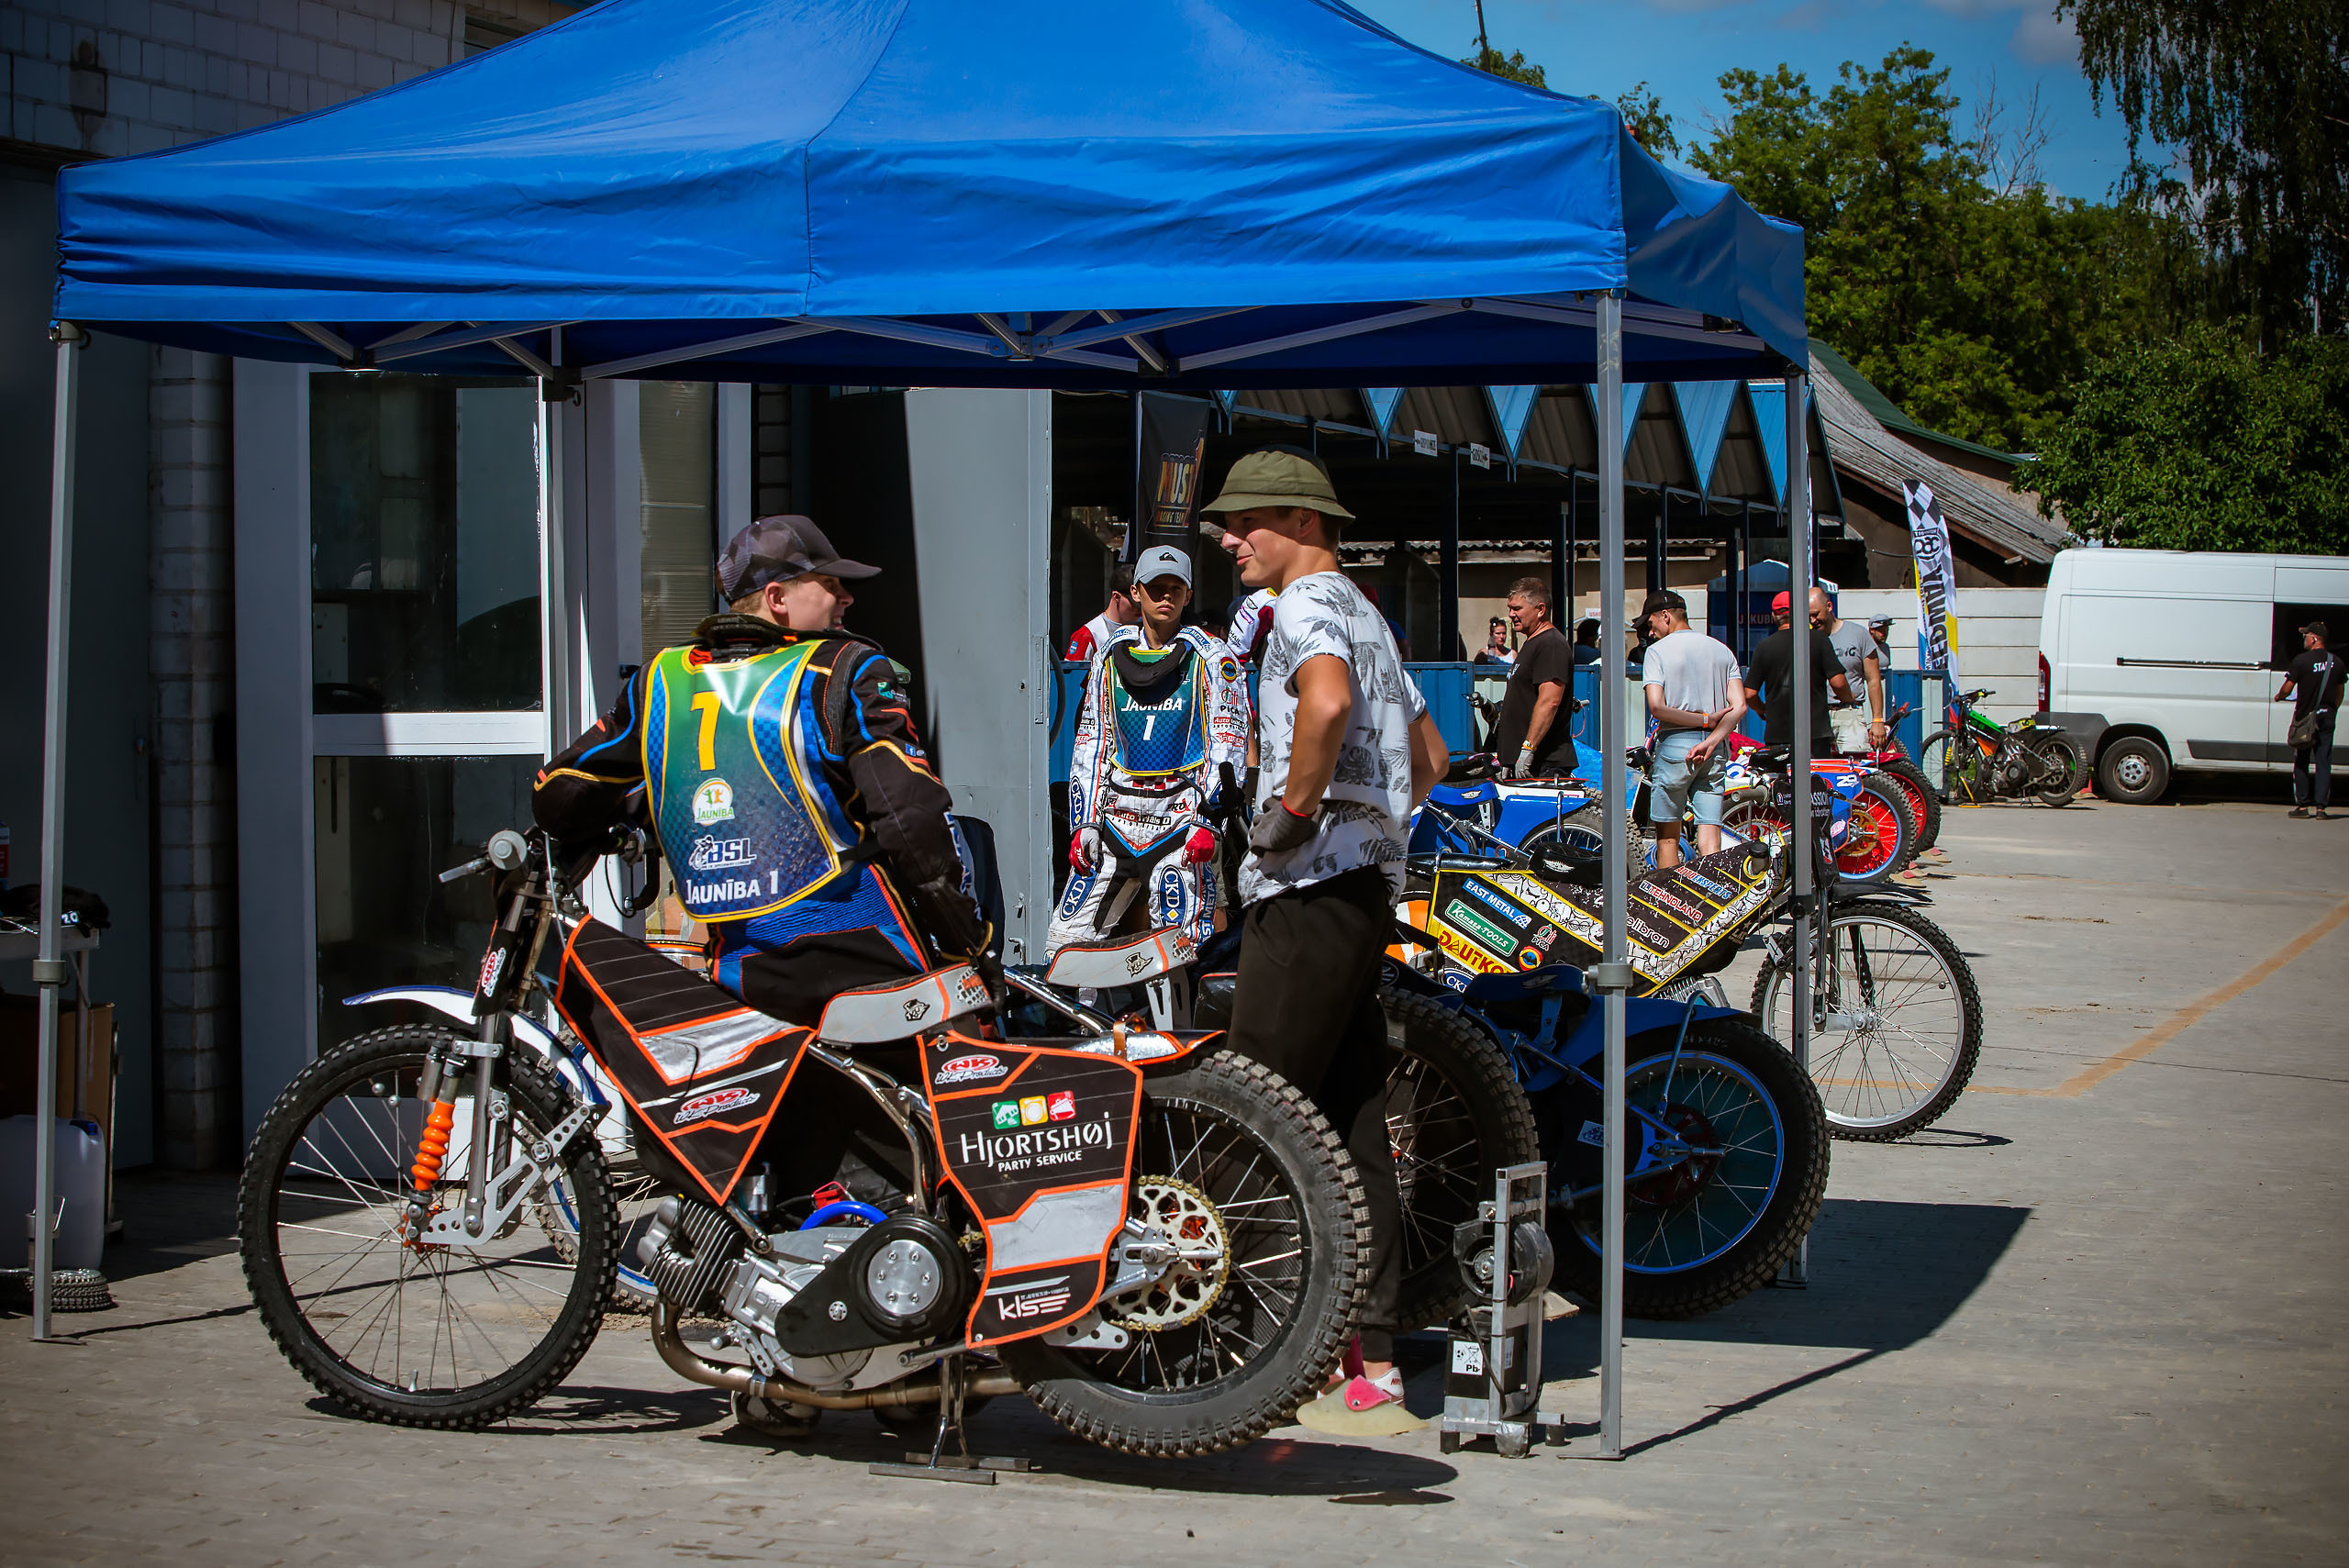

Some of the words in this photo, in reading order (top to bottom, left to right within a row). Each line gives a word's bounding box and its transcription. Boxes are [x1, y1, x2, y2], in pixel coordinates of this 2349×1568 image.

[1142, 715, 1156, 741] 1
[1070, 783, 1084, 815] CKD
[685, 879, 762, 904] JAUNĪBA
[770, 870, 779, 895] 1
[1062, 879, 1086, 917] CKD
[1163, 870, 1180, 908] CKD
[1465, 880, 1490, 900] EAST
[1486, 894, 1515, 918] METAL
[1531, 936, 1551, 951] PICA
[997, 1156, 1031, 1173] PARTY
[1036, 1150, 1083, 1167] SERVICE
[1465, 1363, 1480, 1373] Pb
